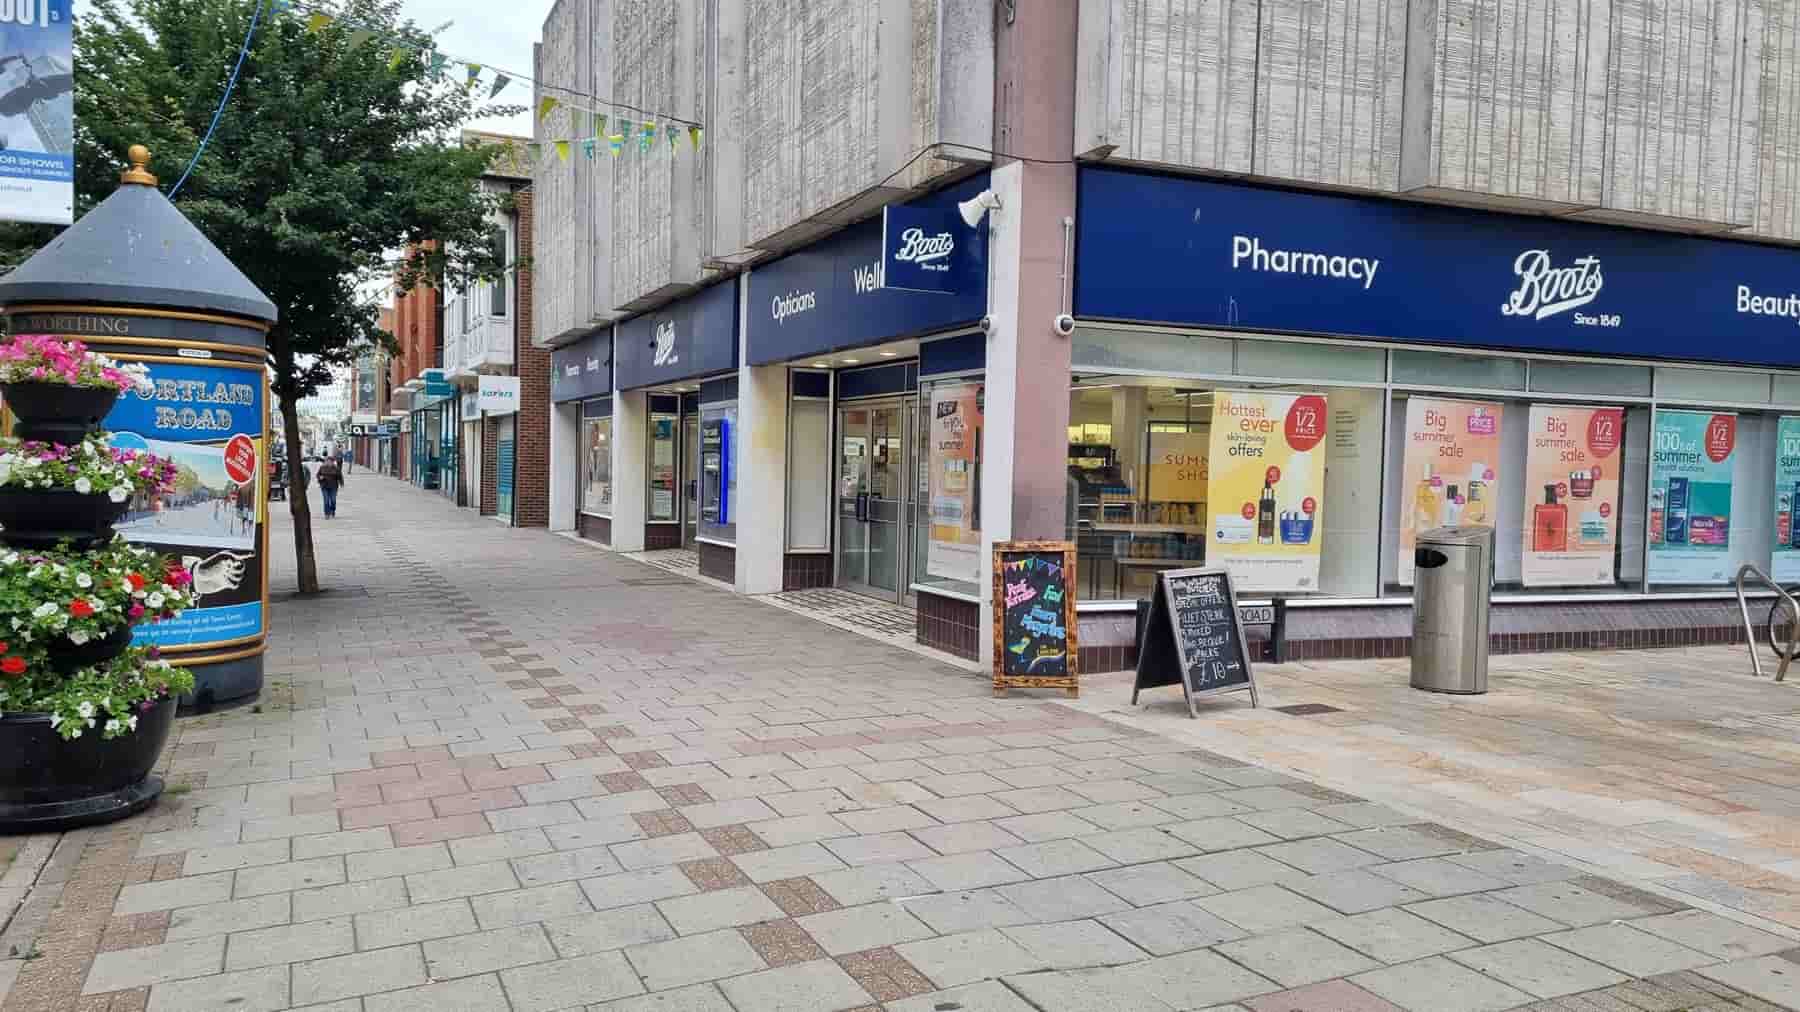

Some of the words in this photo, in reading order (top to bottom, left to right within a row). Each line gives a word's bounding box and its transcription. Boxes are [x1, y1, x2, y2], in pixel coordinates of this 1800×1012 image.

[895, 227, 954, 263] Boots
[1232, 235, 1379, 289] Pharmacy
[853, 259, 882, 295] Well
[1501, 249, 1603, 321] Boots
[772, 289, 816, 326] Opticians
[1737, 284, 1800, 318] Beaut
[32, 316, 129, 333] WORTHING
[1574, 312, 1599, 326] Since
[1599, 314, 1621, 328] 1849
[117, 378, 254, 406] ORTLAND
[1219, 400, 1265, 417] Hottest
[154, 405, 232, 430] ROAD
[1240, 418, 1279, 433] ever
[1295, 411, 1316, 427] 1/2
[1425, 410, 1447, 431] Big
[1547, 416, 1567, 437] Big
[1595, 421, 1613, 436] 1/2
[1413, 431, 1455, 443] summer
[1535, 438, 1576, 449] summer
[1228, 443, 1264, 457] offers
[1439, 442, 1464, 458] sale
[1560, 447, 1585, 462] sale
[1653, 450, 1702, 464] summer
[1177, 470, 1208, 481] SHO
